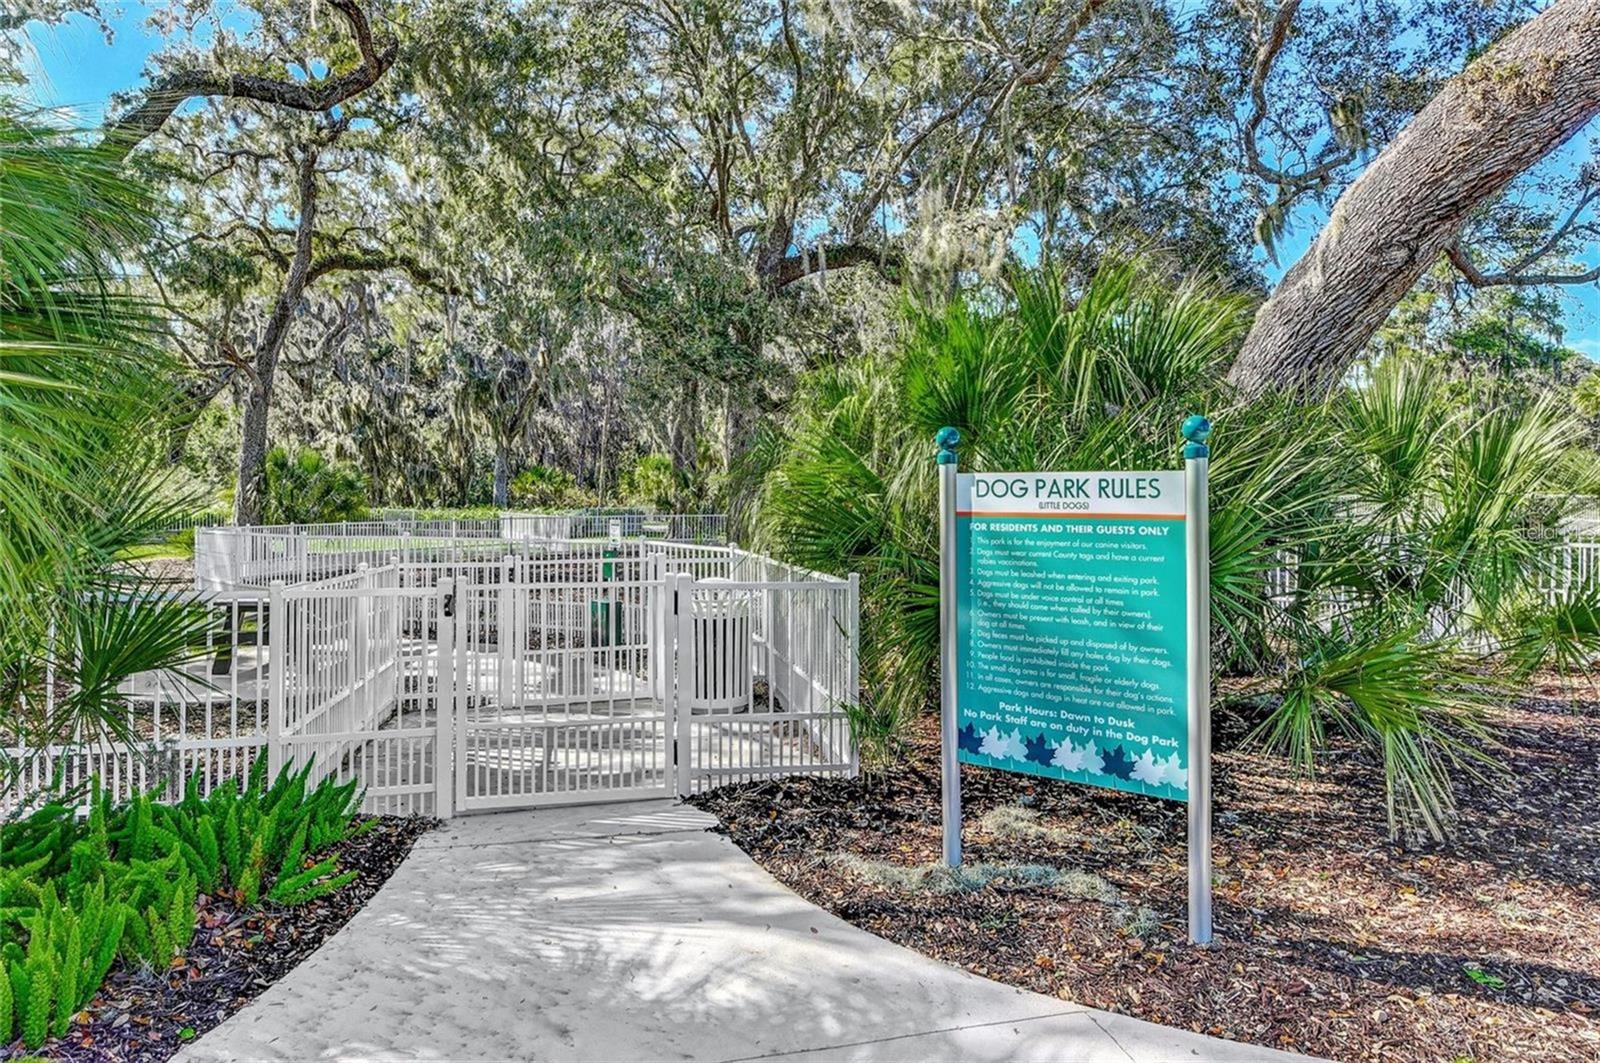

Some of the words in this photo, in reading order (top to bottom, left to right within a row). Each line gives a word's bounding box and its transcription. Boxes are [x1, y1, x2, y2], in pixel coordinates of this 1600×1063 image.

[976, 479, 1029, 498] DOG
[1035, 479, 1090, 498] PARK
[1098, 478, 1161, 498] RULES
[1062, 502, 1089, 510] DOGS)
[970, 523, 988, 531] FOR
[990, 523, 1038, 532] RESIDENTS
[1041, 524, 1063, 533] AND
[1066, 525, 1093, 534] THEIR
[1097, 526, 1135, 535] GUESTS
[1139, 527, 1170, 536] ONLY
[991, 538, 1005, 547] park
[1036, 539, 1071, 549] enjoyment
[1072, 540, 1080, 548] of
[1095, 541, 1119, 549] canine
[1120, 542, 1147, 550] visitors.
[977, 548, 993, 558] Dogs
[1053, 551, 1077, 561] County
[1079, 553, 1094, 561] tags
[1111, 553, 1130, 561] have
[977, 569, 993, 578] Dogs
[1020, 571, 1046, 579] leashed
[1048, 572, 1066, 580] when
[1067, 574, 1096, 583] entering
[1114, 575, 1138, 586] exiting
[1140, 577, 1159, 586] park.
[977, 579, 1012, 588] Aggressive
[1014, 581, 1030, 590] dogs
[1055, 583, 1065, 591] be
[1067, 584, 1093, 592] allowed
[1132, 587, 1139, 595] in
[1140, 588, 1160, 597] park.
[977, 590, 993, 600] Dogs
[1011, 592, 1019, 600] be
[1021, 593, 1039, 601] under
[1105, 598, 1124, 606] times
[993, 601, 1007, 610] they
[1008, 602, 1029, 610] should
[1050, 605, 1069, 613] when
[1070, 606, 1091, 614] called
[1092, 607, 1102, 617] by
[1103, 608, 1119, 616] their
[977, 610, 1002, 619] Owners
[1110, 620, 1117, 628] in
[1119, 621, 1135, 630] view
[1147, 623, 1164, 632] their
[977, 619, 990, 629] dog
[977, 630, 991, 640] Dog
[1026, 634, 1035, 642] be
[1036, 636, 1058, 645] picked
[1059, 639, 1069, 647] up
[1071, 639, 1084, 647] and
[1086, 640, 1117, 650] disposed
[1119, 643, 1127, 651] of
[1129, 643, 1138, 654] by
[977, 641, 1002, 650] Owners
[1071, 652, 1084, 660] any
[1085, 651, 1104, 660] holes
[1105, 653, 1120, 664] dug
[1122, 655, 1132, 665] by
[1133, 656, 1151, 665] their
[977, 652, 998, 662] People
[1000, 654, 1015, 662] food
[1023, 657, 1057, 667] prohibited
[1080, 662, 1091, 670] the
[1093, 664, 1111, 673] park.
[990, 665, 1007, 673] small
[1008, 666, 1021, 676] dog
[1046, 670, 1057, 678] for
[1080, 674, 1103, 684] fragile
[1114, 678, 1140, 689] elderly
[985, 674, 993, 682] all
[1053, 684, 1092, 693] responsible
[1094, 686, 1104, 695] for
[1123, 690, 1144, 701] dog's
[978, 685, 1012, 696] Aggressive
[1013, 689, 1029, 700] dogs
[1031, 692, 1044, 700] and
[1045, 693, 1062, 704] dogs
[1064, 695, 1071, 703] in
[1072, 696, 1088, 705] heat
[1116, 702, 1146, 713] allowed
[1147, 705, 1155, 714] in
[1156, 708, 1176, 717] park.
[999, 703, 1022, 713] Park
[1025, 706, 1057, 718] Hours:
[1061, 710, 1091, 723] Dawn
[1094, 715, 1104, 724] to
[1109, 717, 1135, 728] Dusk
[964, 709, 977, 718] No
[980, 711, 1002, 722] Park
[1005, 715, 1027, 726] Staff
[1030, 720, 1047, 728] are
[1050, 723, 1063, 731] on
[1066, 723, 1089, 737] duty
[1093, 727, 1102, 736] in
[1106, 729, 1123, 739] the
[1126, 732, 1148, 746] Dog
[1152, 735, 1179, 748] Park
